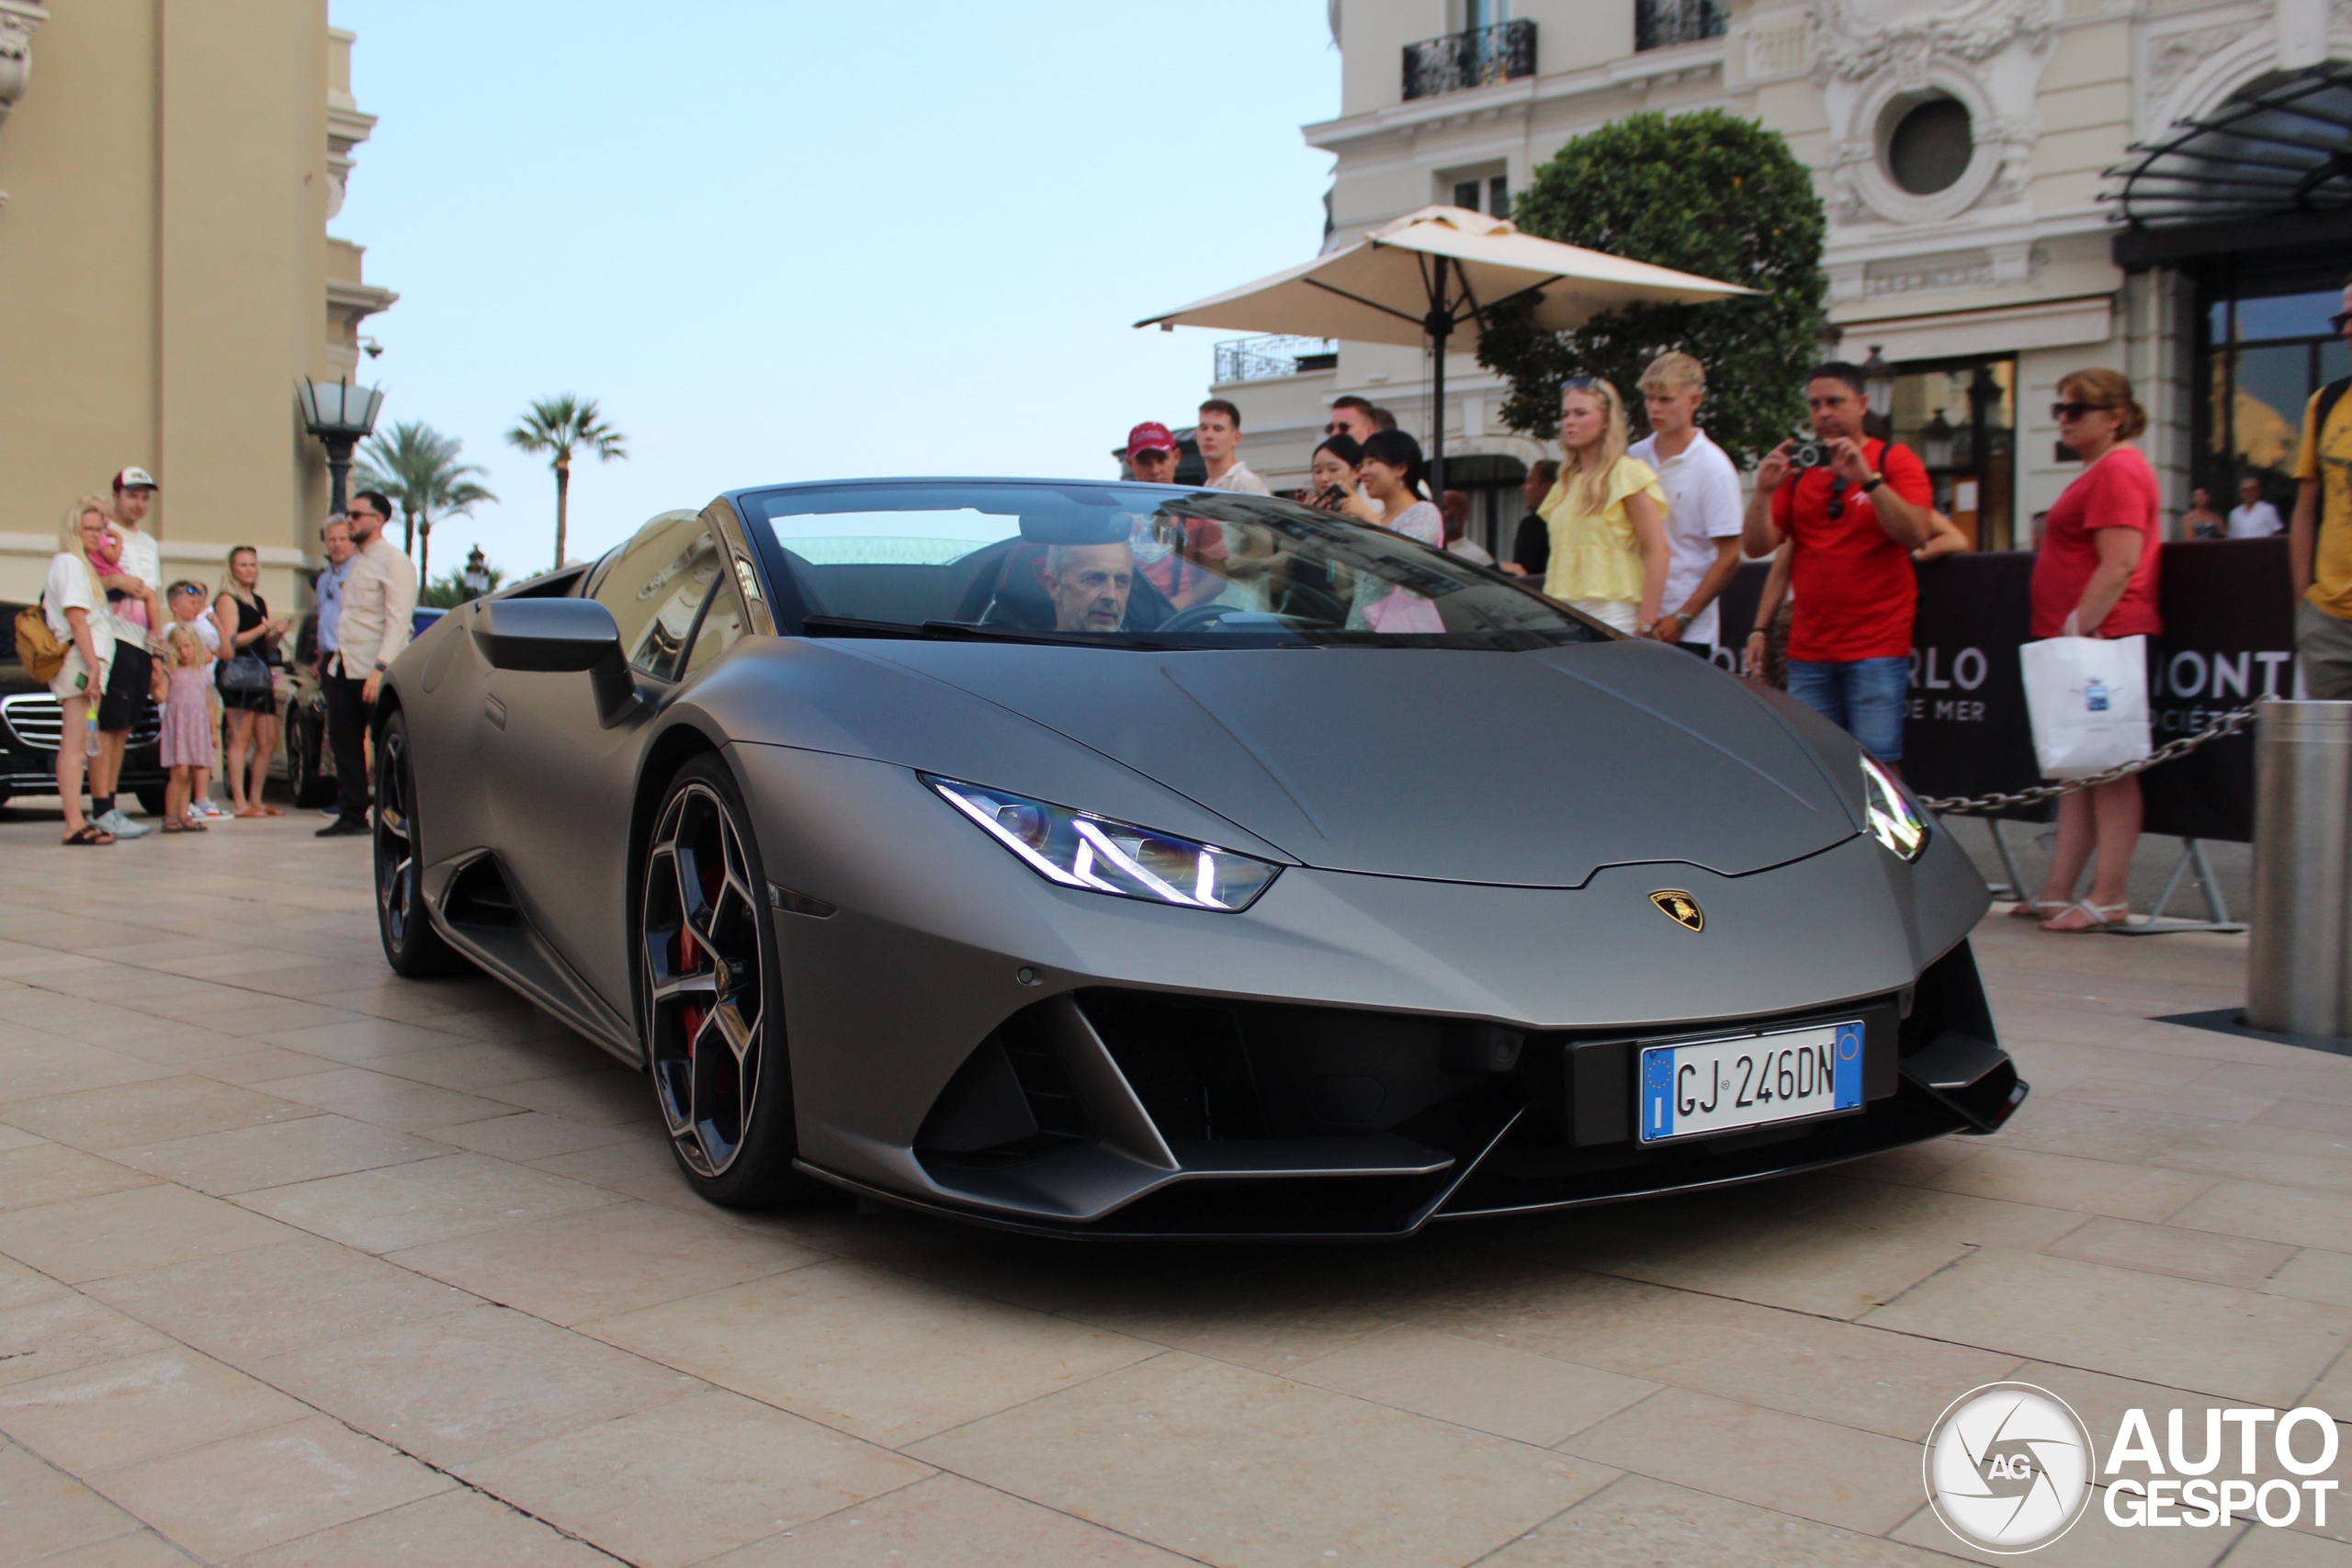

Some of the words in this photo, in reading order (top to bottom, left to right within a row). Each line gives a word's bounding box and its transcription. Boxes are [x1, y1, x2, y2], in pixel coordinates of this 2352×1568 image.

[2154, 650, 2308, 701] ONT
[1935, 700, 1986, 722] MER
[1677, 1058, 1719, 1117] GJ
[1736, 1043, 1835, 1109] 246DN
